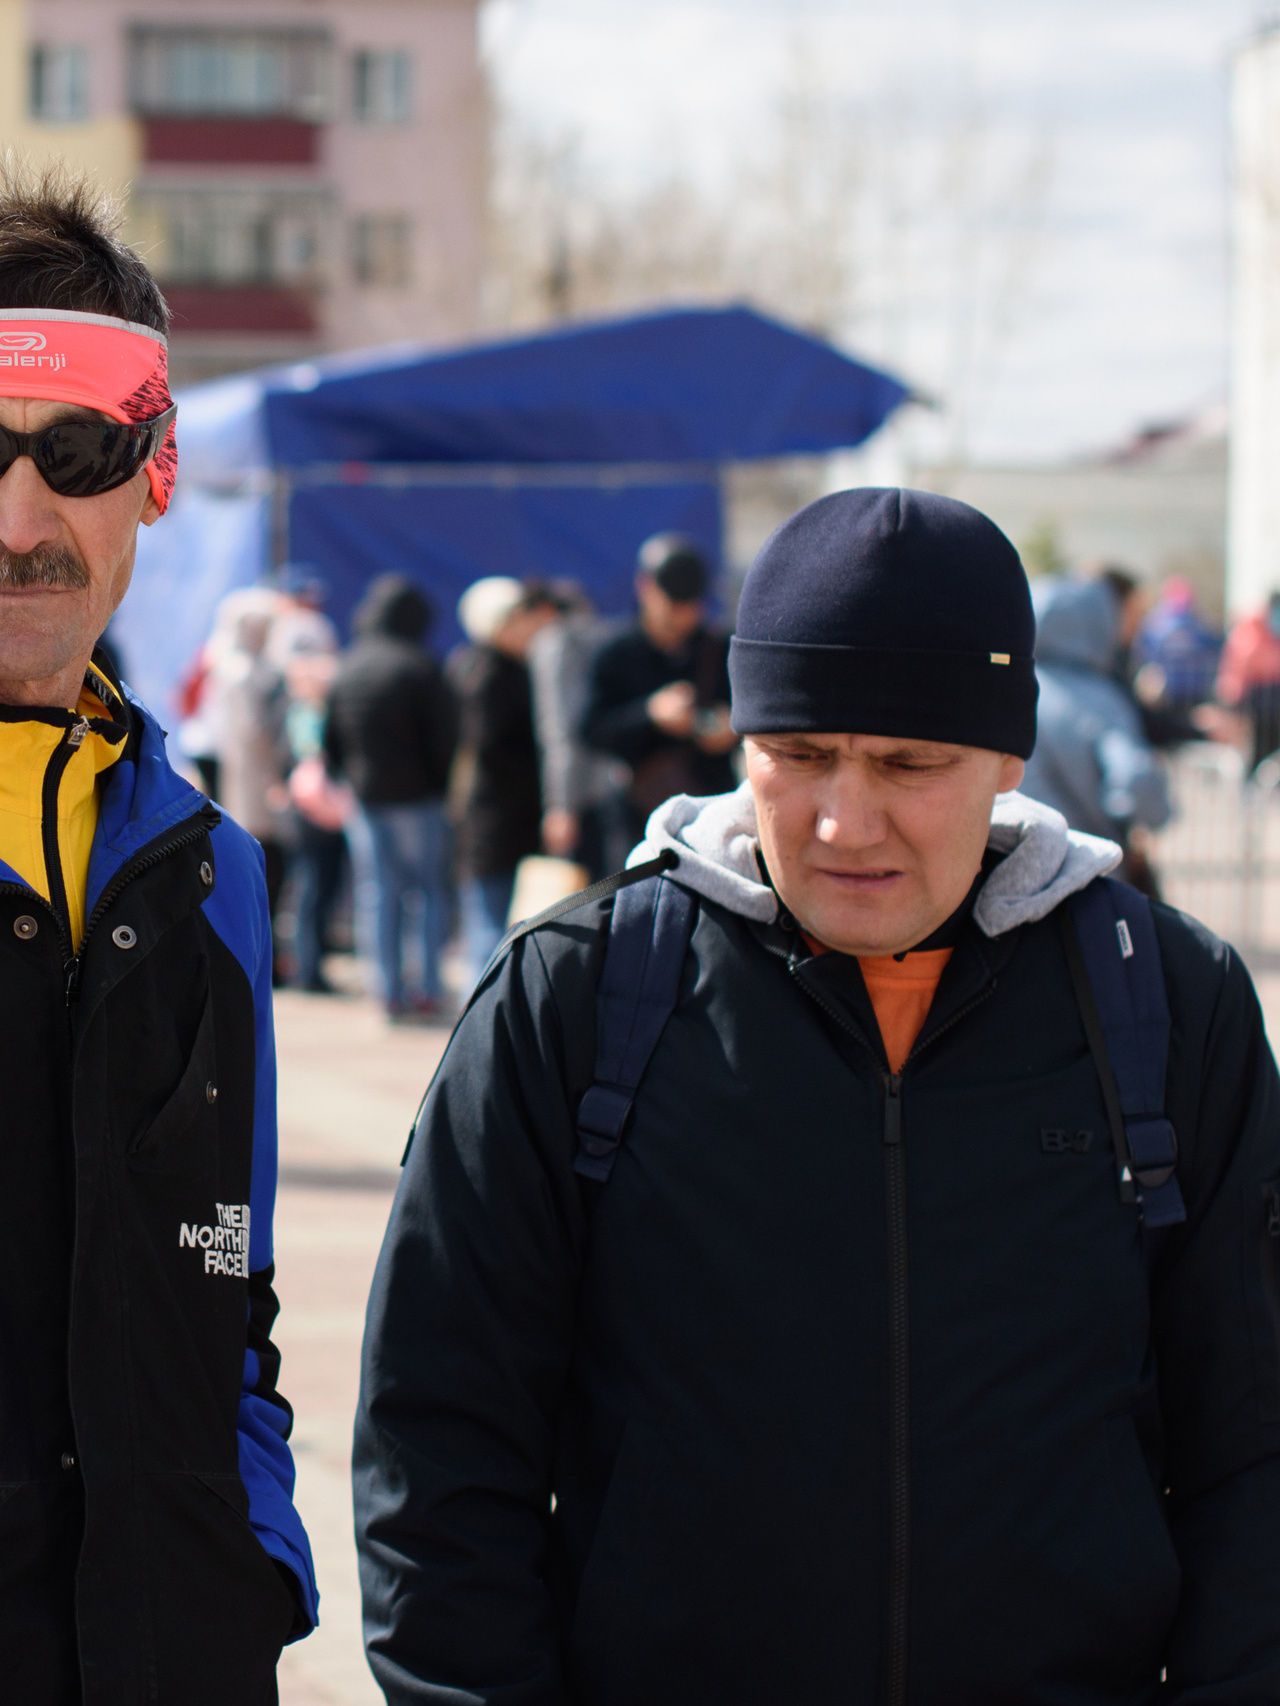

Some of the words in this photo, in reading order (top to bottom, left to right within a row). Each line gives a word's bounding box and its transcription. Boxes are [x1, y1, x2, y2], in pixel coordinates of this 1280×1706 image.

[215, 1202, 243, 1228] THE
[179, 1222, 243, 1252] NORTH
[204, 1249, 243, 1278] FACE
